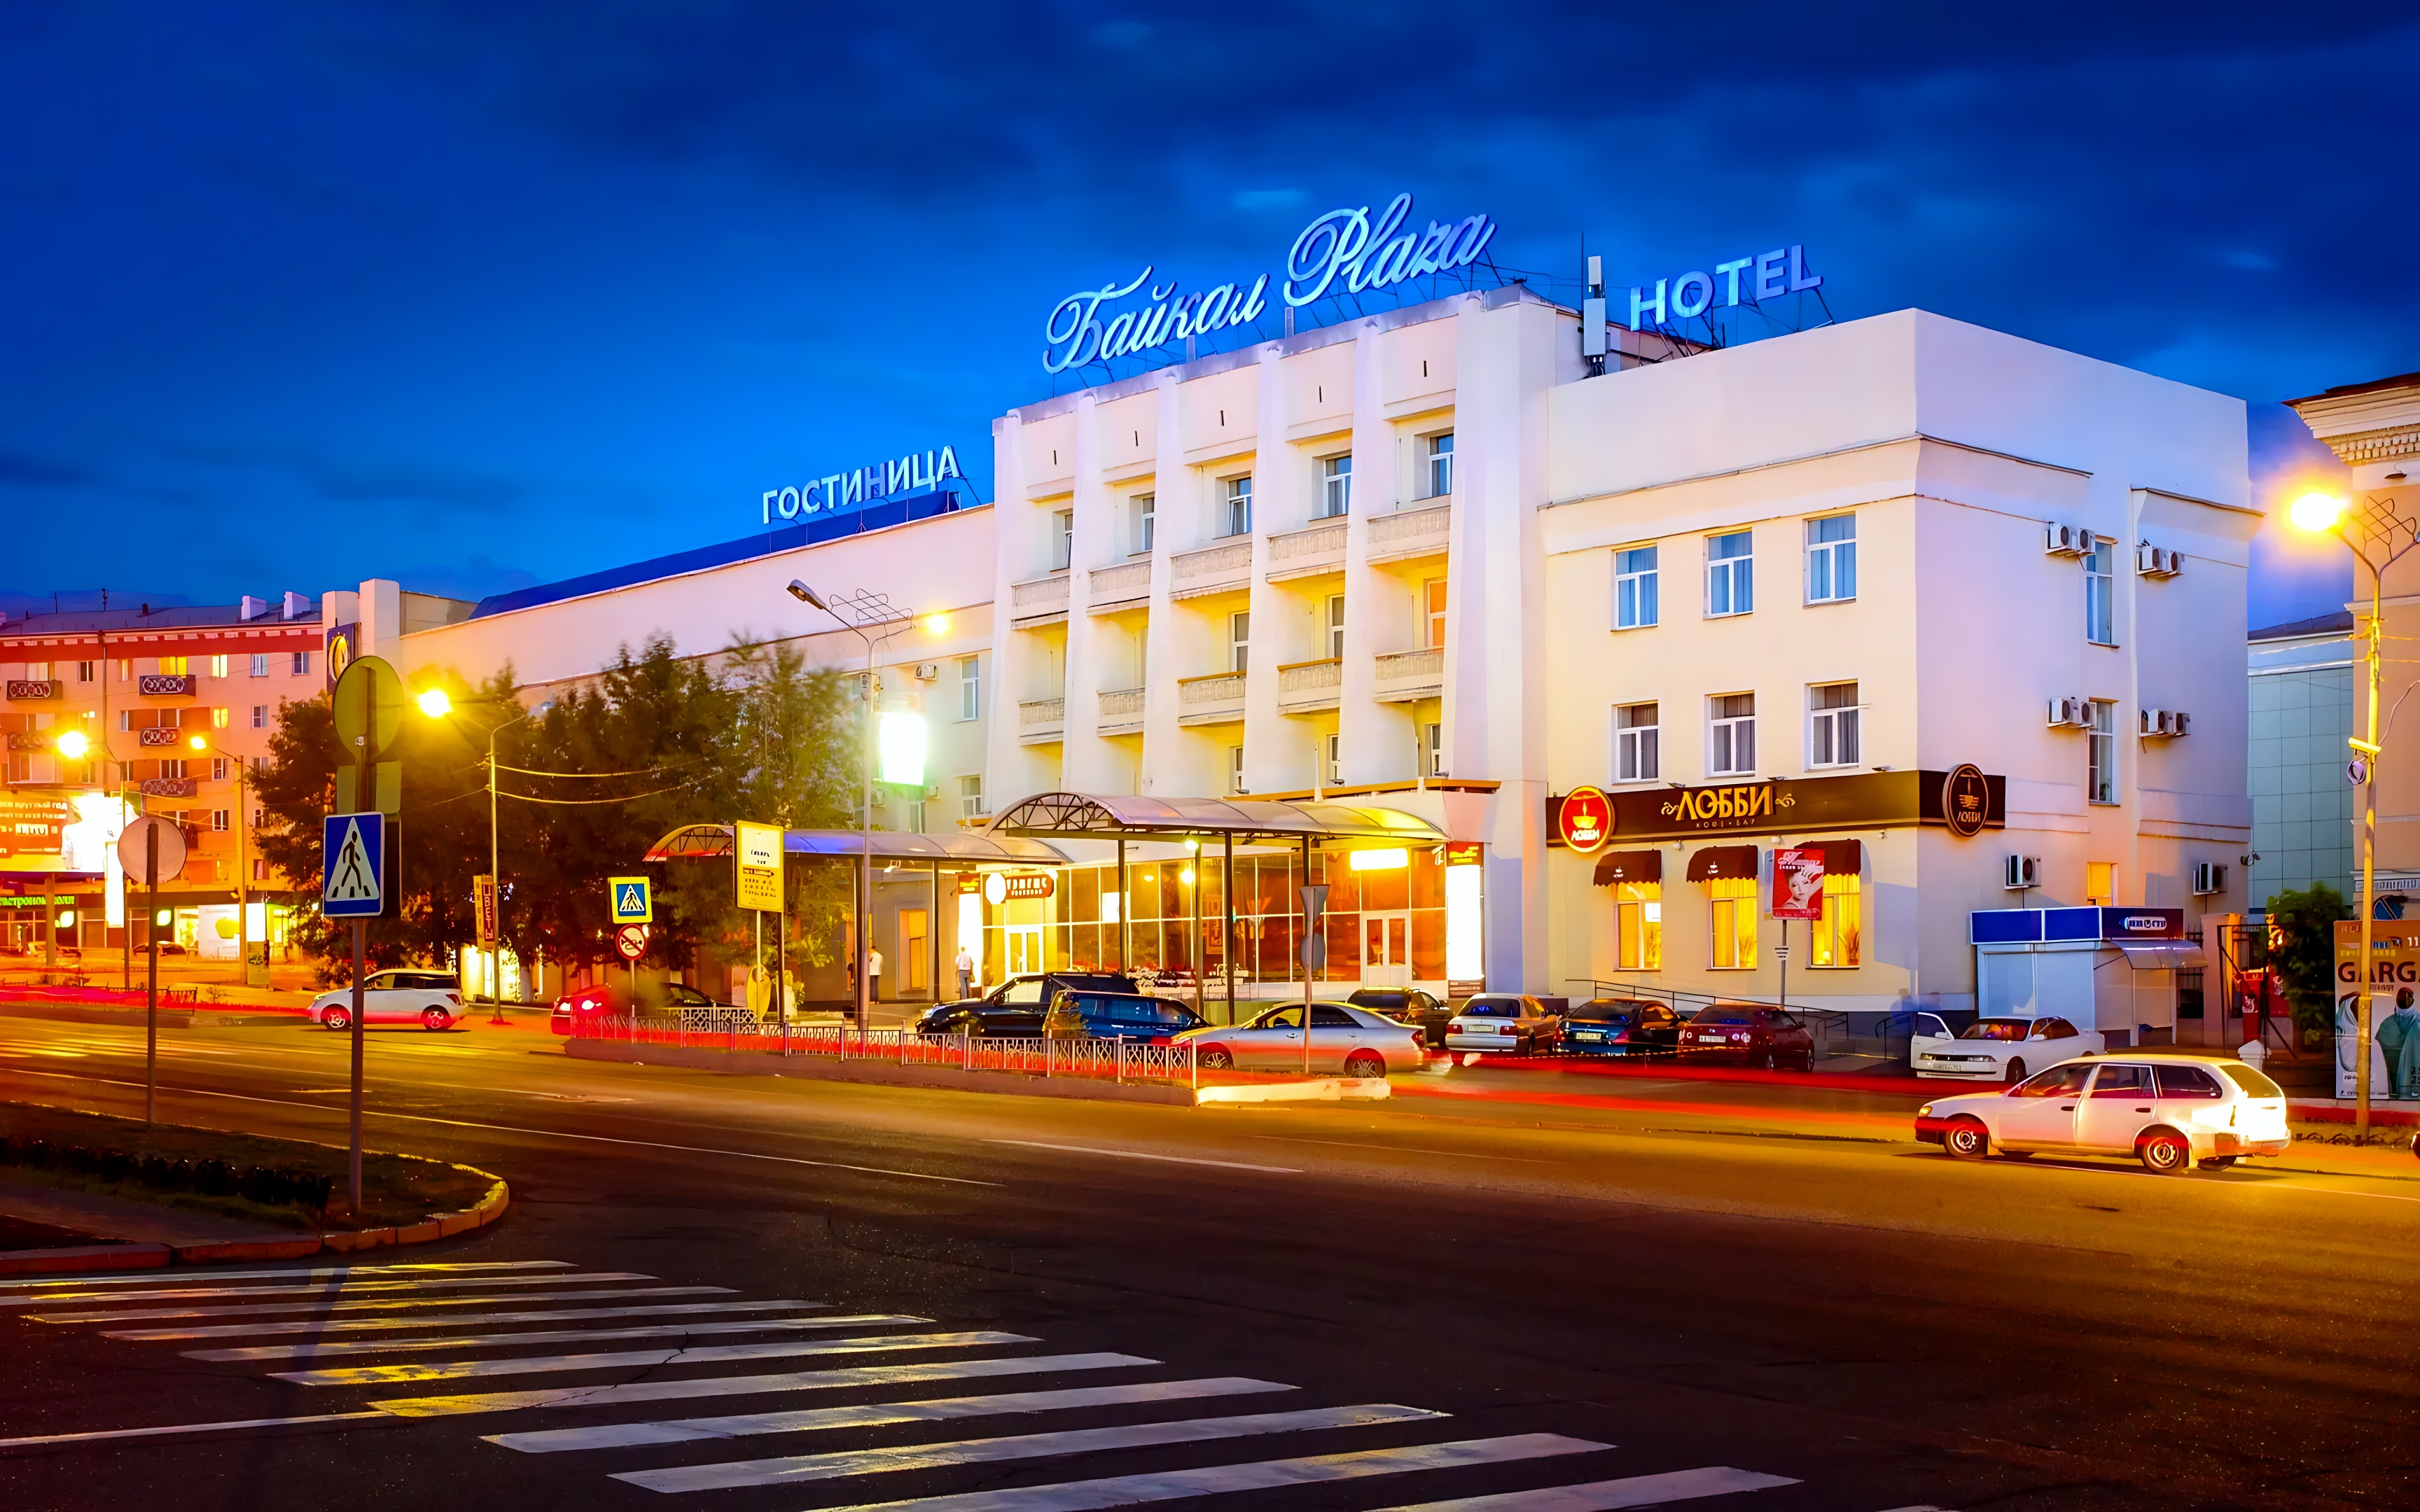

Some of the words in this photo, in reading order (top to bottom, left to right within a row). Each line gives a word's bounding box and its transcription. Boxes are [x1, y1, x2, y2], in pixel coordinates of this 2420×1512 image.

[1042, 265, 1271, 374] Байкал
[1283, 192, 1497, 307] Plaza
[1630, 245, 1822, 332] HOTEL
[763, 445, 960, 524] ГОСТИНИЦА
[1676, 786, 1774, 821] ЛОББИ
[482, 884, 494, 939] ЦВЕТЫ
[2337, 961, 2420, 983] GRG
